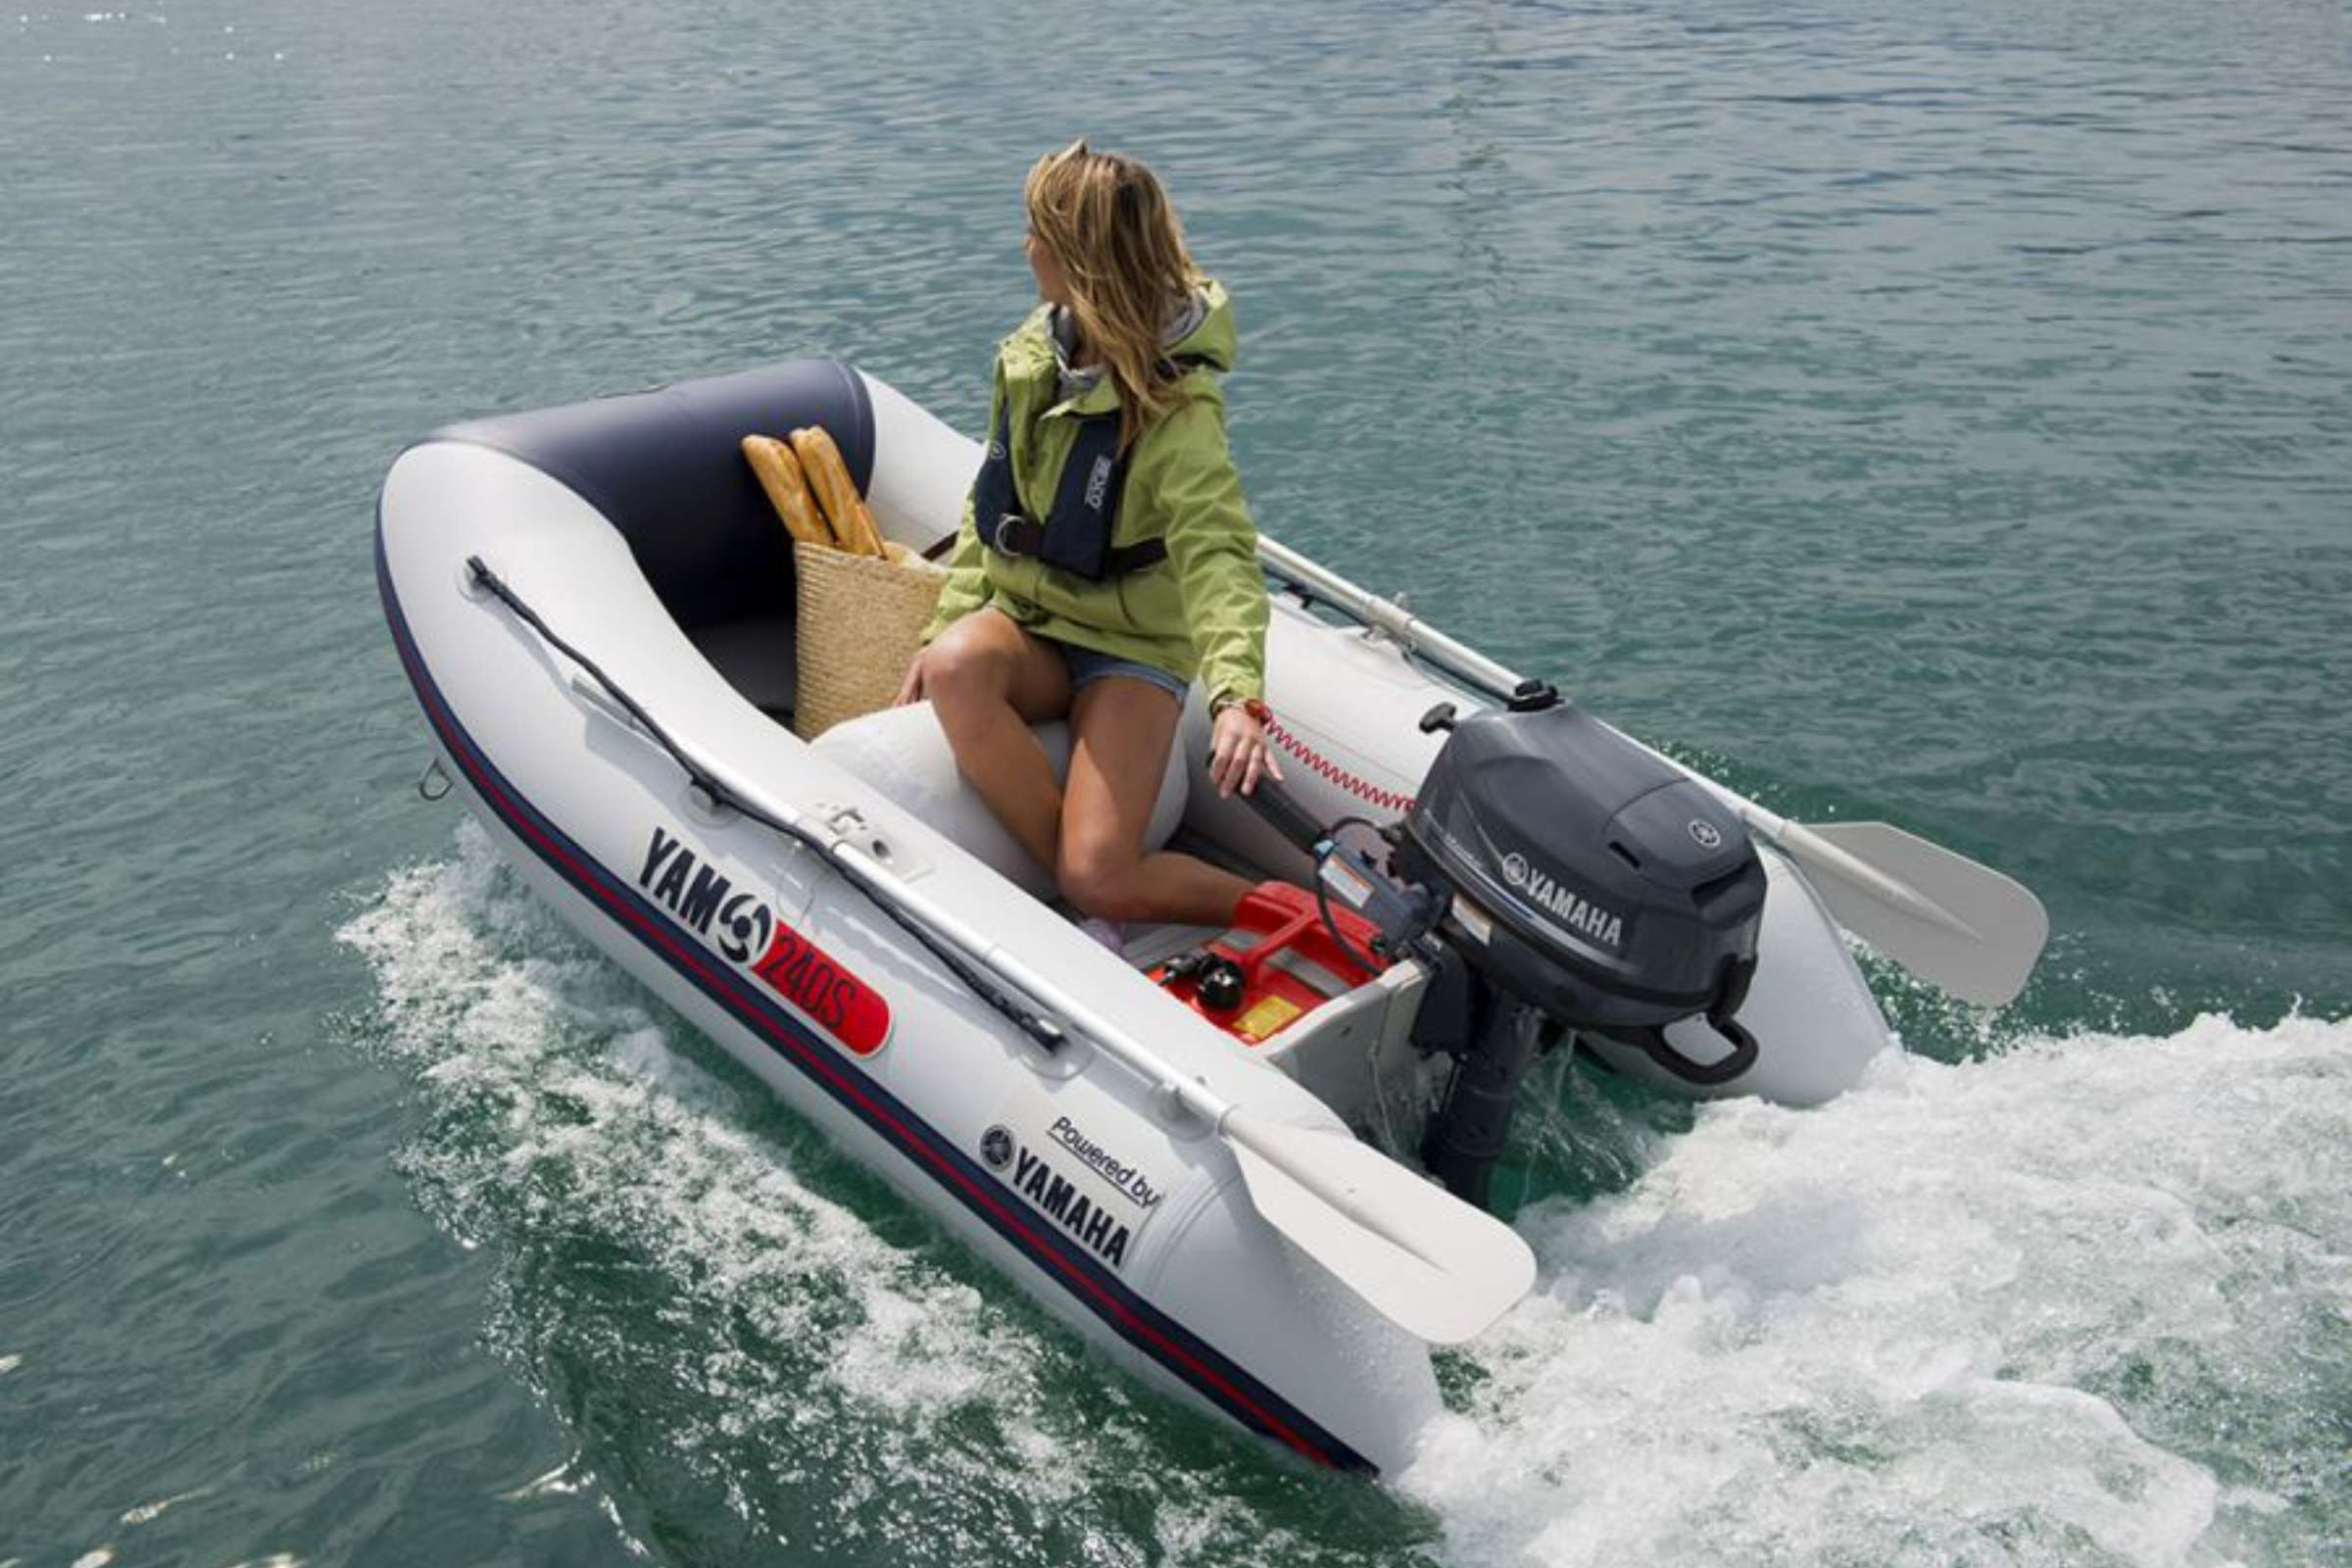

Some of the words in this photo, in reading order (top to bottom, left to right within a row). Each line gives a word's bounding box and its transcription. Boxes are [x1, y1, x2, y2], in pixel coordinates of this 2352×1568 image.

[638, 826, 731, 935] YAM
[1527, 868, 1623, 946] YAMAHA
[1013, 1146, 1130, 1267] YAMAHA
[1051, 1115, 1137, 1187] Powered
[1131, 1174, 1162, 1208] by
